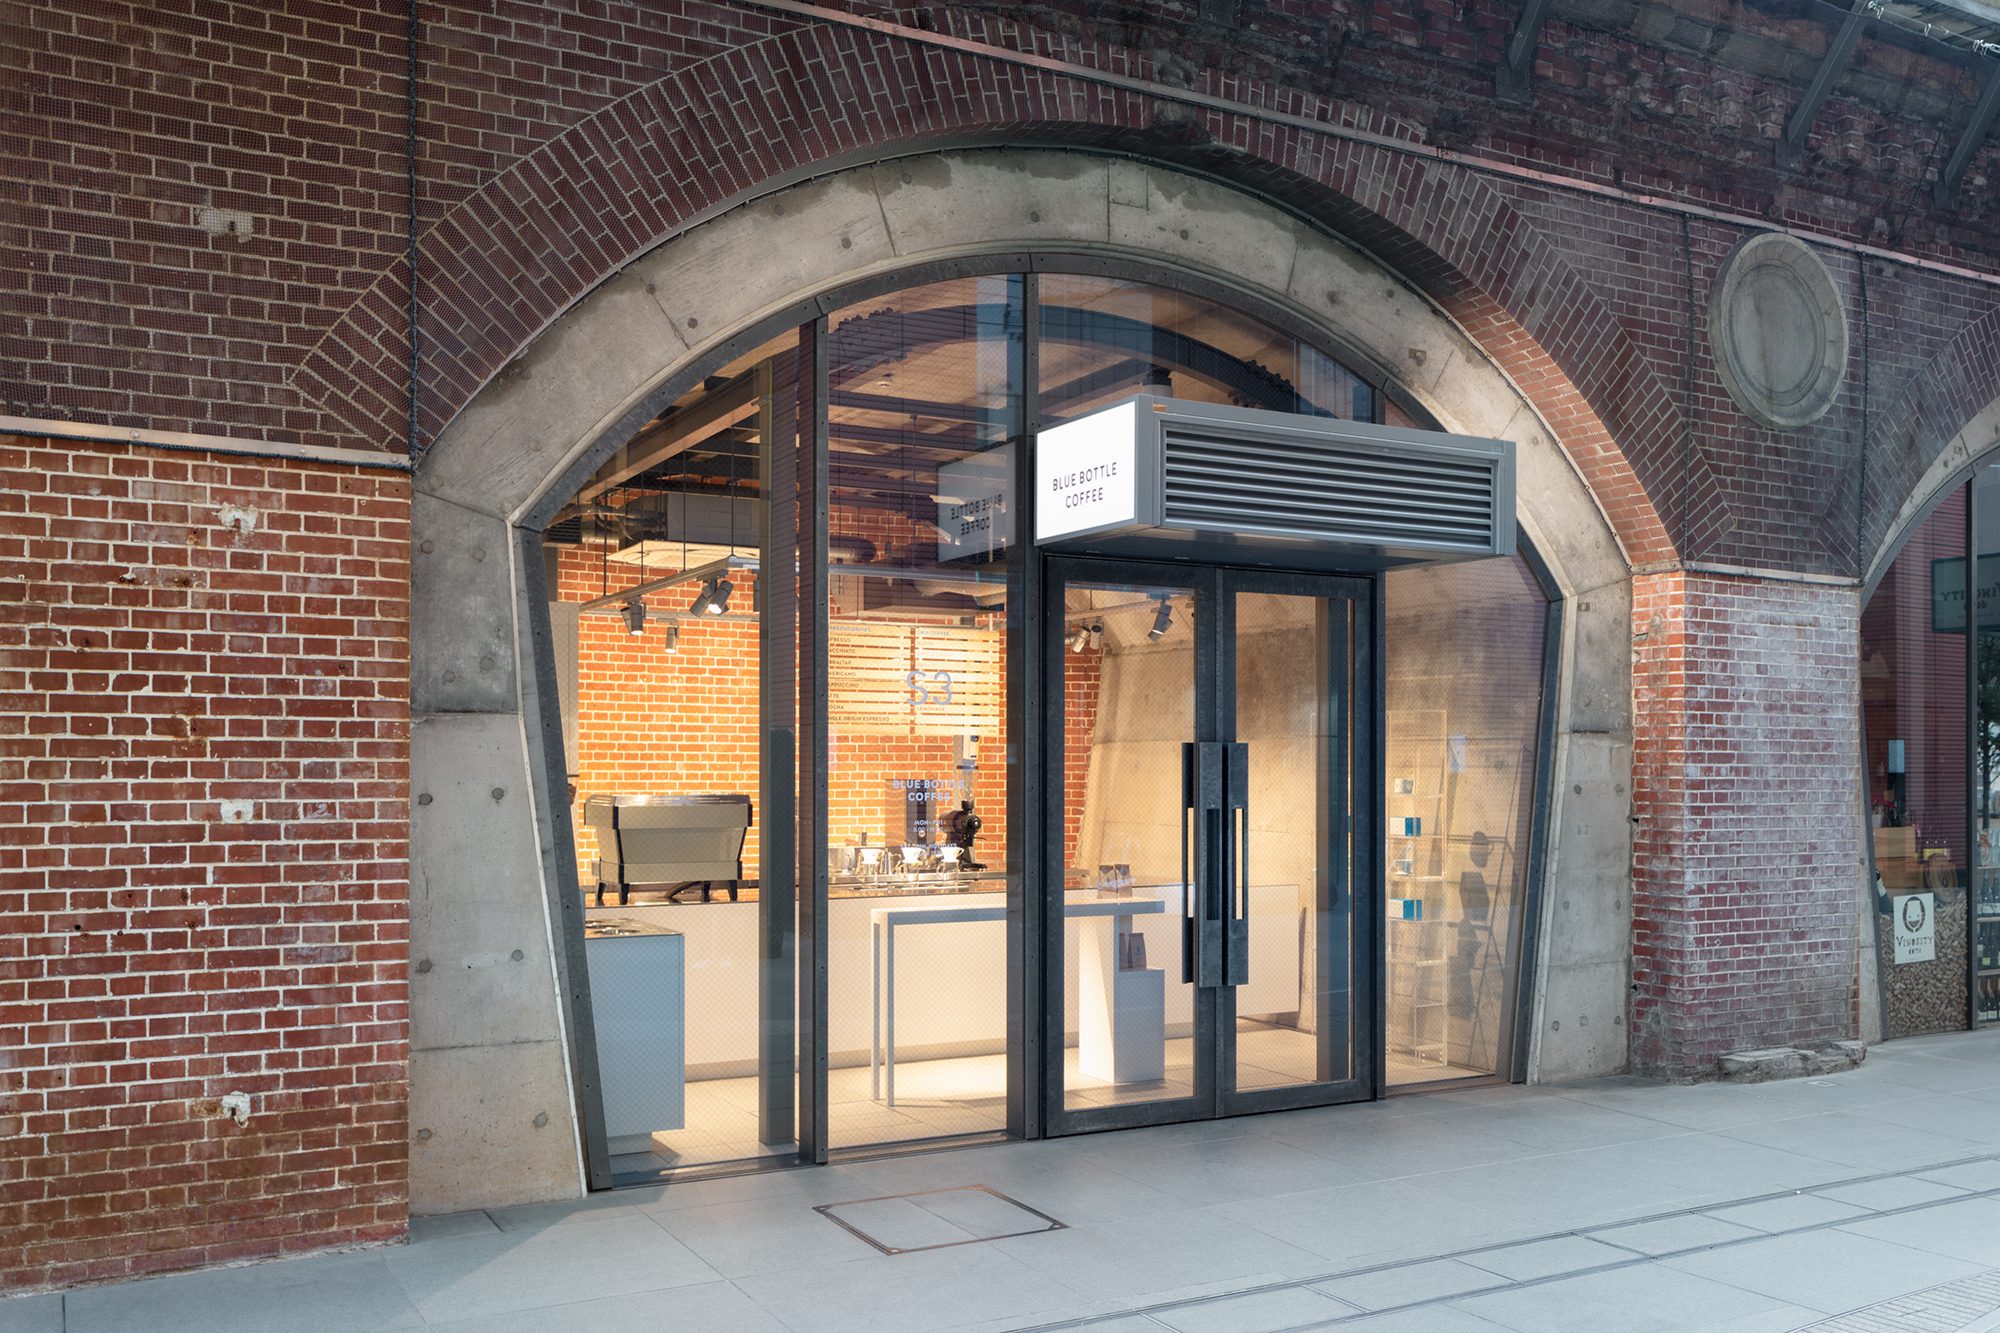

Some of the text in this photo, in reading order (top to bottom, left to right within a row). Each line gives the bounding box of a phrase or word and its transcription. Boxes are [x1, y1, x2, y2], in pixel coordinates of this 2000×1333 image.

[1052, 462, 1117, 491] BLUE BOTTLE
[1065, 487, 1104, 508] COFFEE
[892, 780, 965, 789] BLUE BOTTLE
[908, 792, 951, 801] COFFEE
